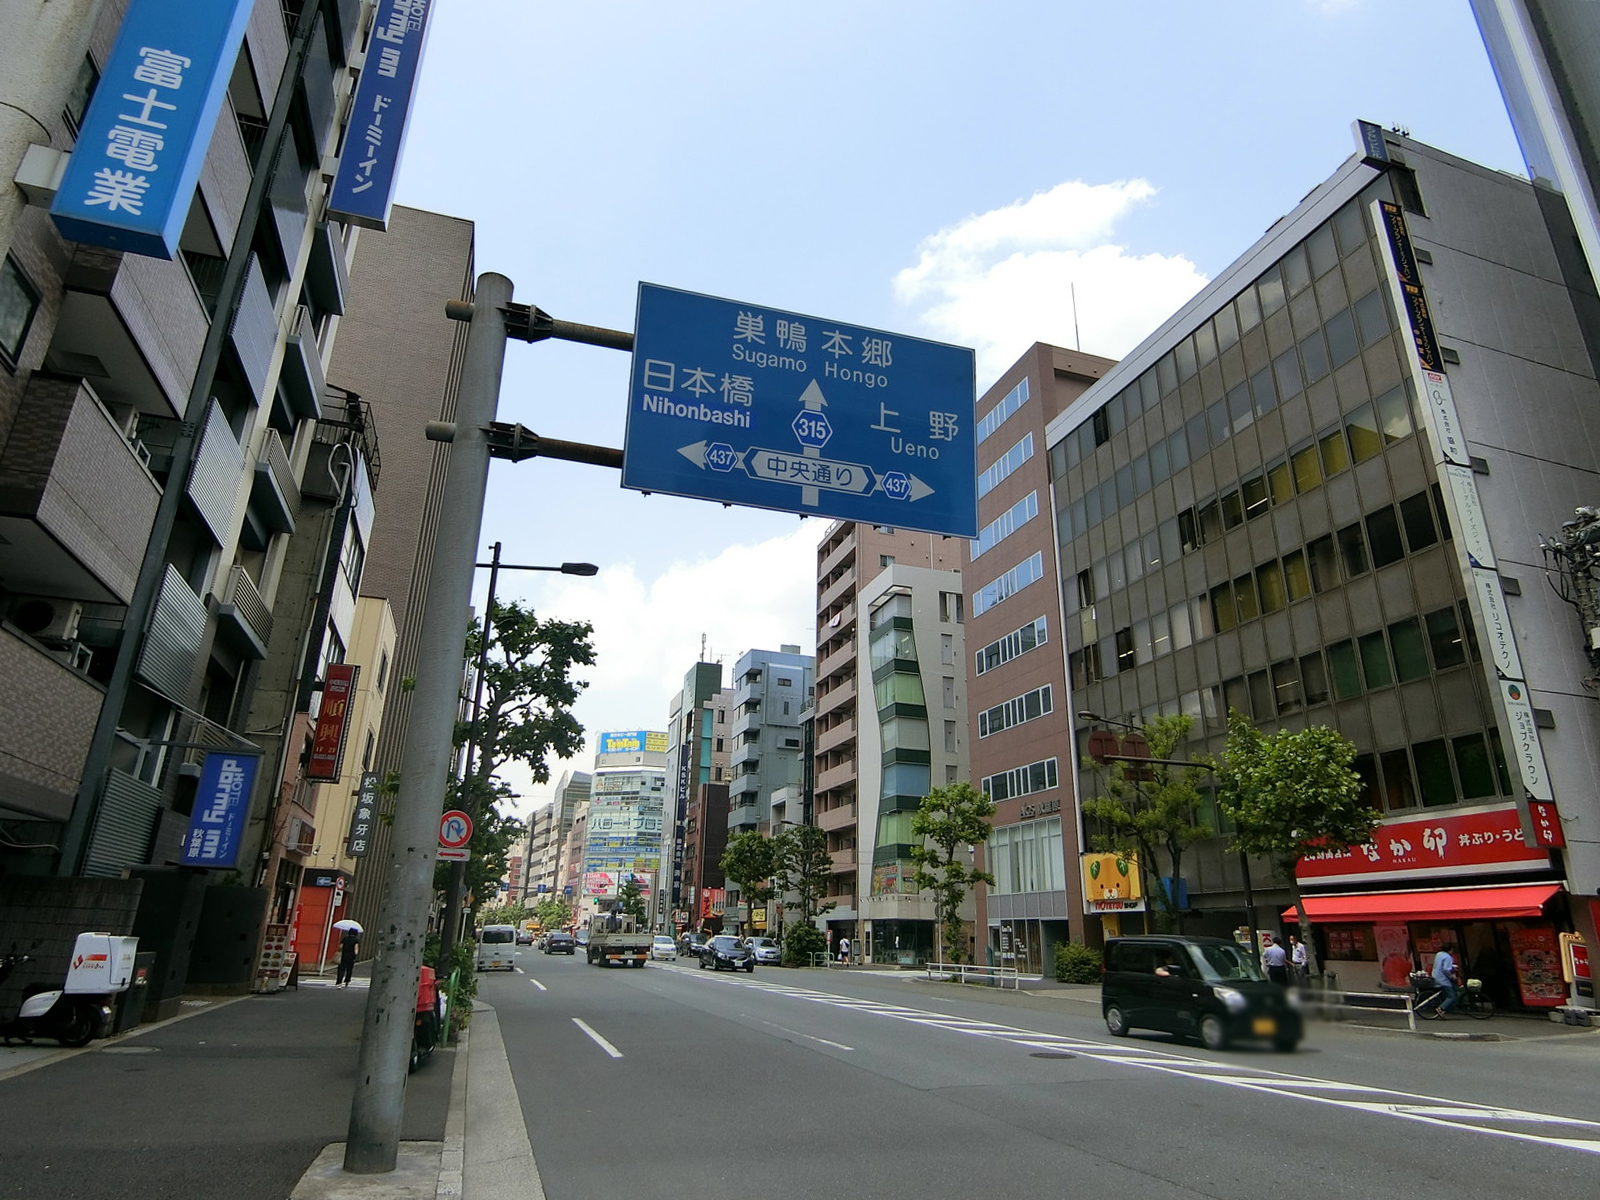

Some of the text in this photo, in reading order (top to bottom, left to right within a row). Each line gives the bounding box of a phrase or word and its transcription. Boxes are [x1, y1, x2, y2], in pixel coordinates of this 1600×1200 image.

[377, 47, 401, 78] inn
[84, 46, 192, 216] 富士電業
[352, 95, 392, 194] ドーミーイン
[732, 310, 893, 368] 巣鴨 本郷
[731, 343, 807, 373] Sugamo
[643, 358, 754, 407] 日本橋
[824, 362, 888, 389] Hongo
[642, 394, 750, 429] Nihonbashi
[870, 401, 959, 442] 上野
[798, 418, 826, 440] 315
[709, 449, 733, 466] 437
[890, 436, 940, 461] Ueno
[767, 455, 853, 487] 中央通り
[885, 478, 907, 493] 437
[606, 738, 640, 749] TamTam
[201, 759, 243, 858] dormy inn
[1537, 804, 1553, 843] なか卯
[187, 828, 205, 858] 秋葉原
